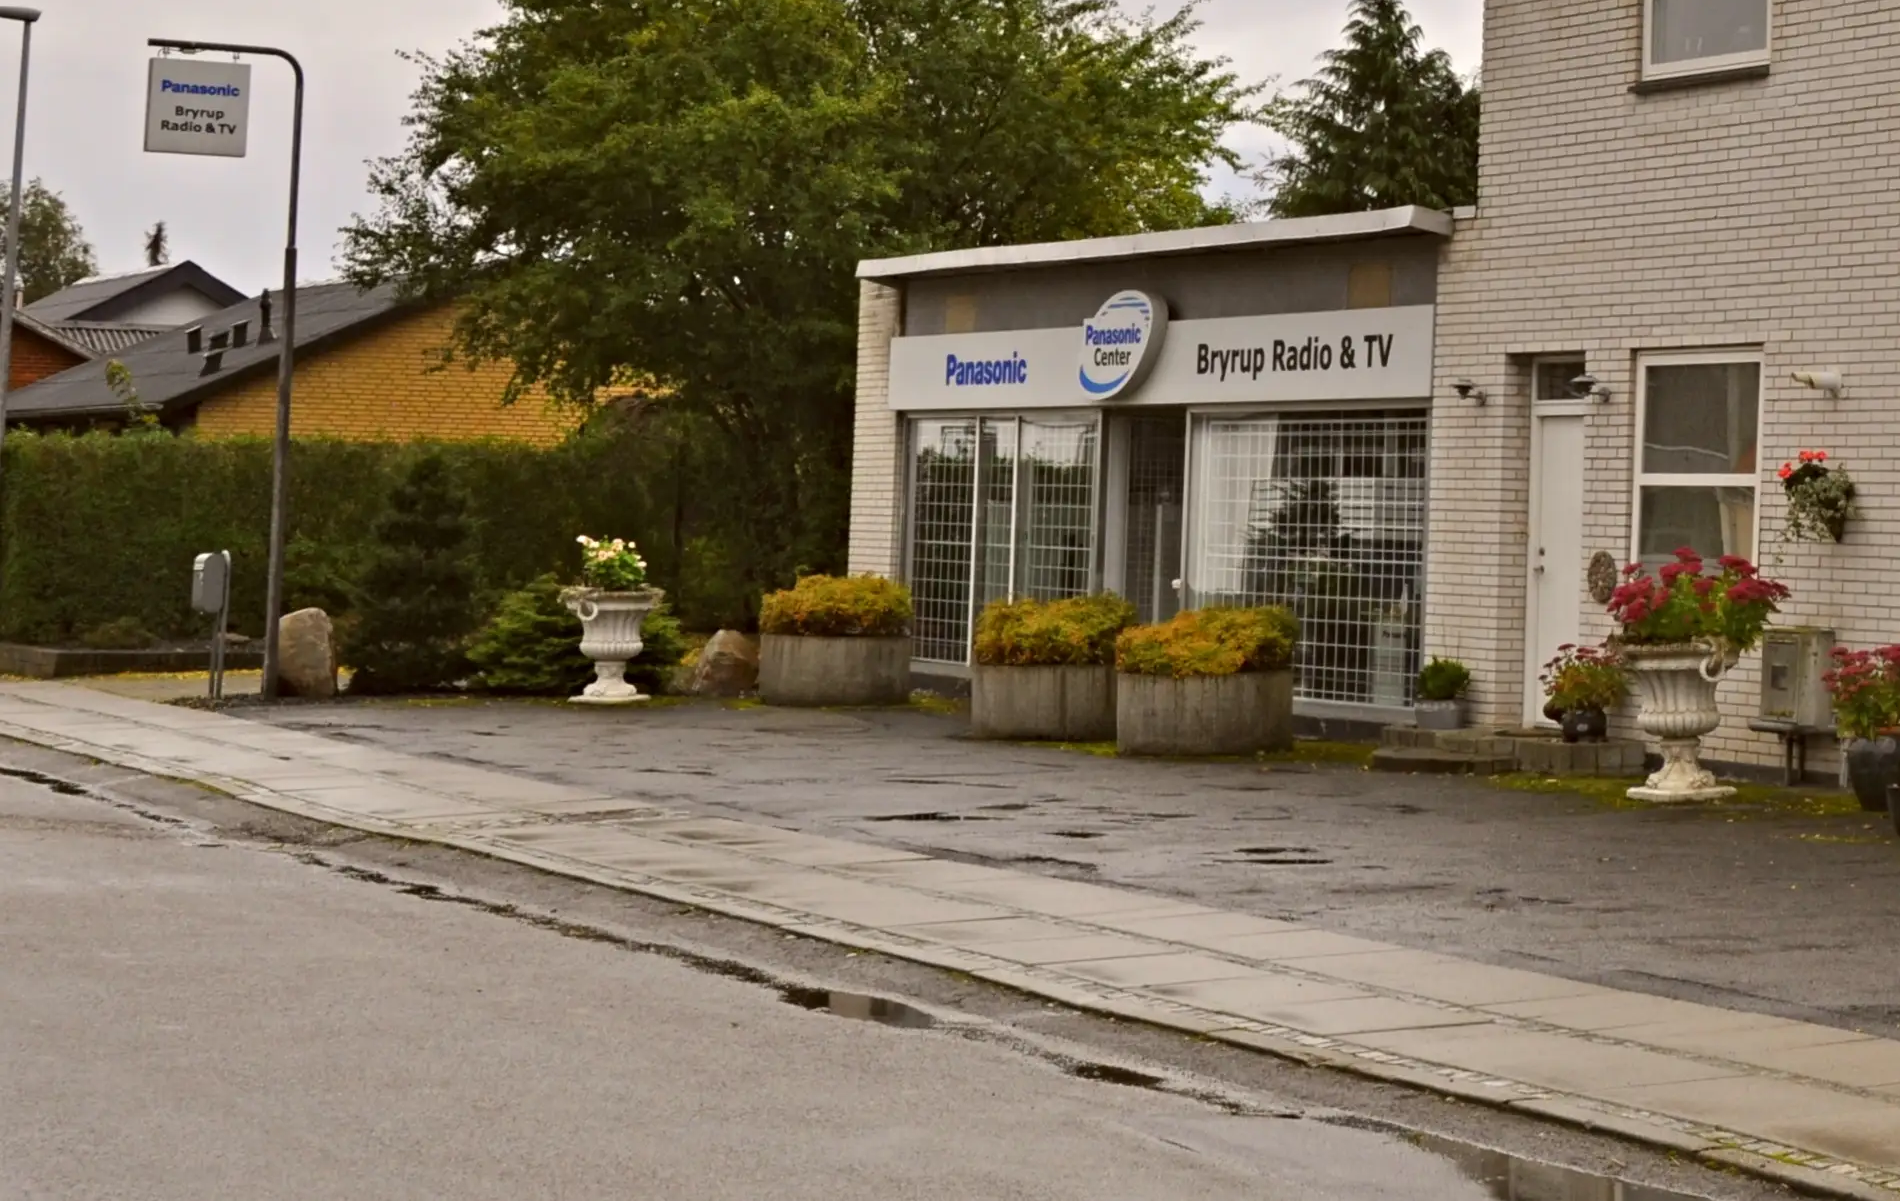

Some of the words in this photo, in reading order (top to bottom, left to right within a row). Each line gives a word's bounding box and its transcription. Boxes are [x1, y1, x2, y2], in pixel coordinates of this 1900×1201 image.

[161, 79, 240, 97] Panasonic
[175, 105, 225, 120] Bryrup
[160, 120, 202, 133] Radio
[205, 123, 216, 134] &
[218, 124, 237, 134] TV
[1085, 323, 1142, 345] Panasonic
[1094, 347, 1131, 367] Center
[1196, 343, 1265, 382] Bryrup
[1272, 336, 1332, 372] Radio
[1340, 335, 1356, 369] &
[1364, 333, 1394, 368] TV
[946, 351, 1027, 386] Panasonic
